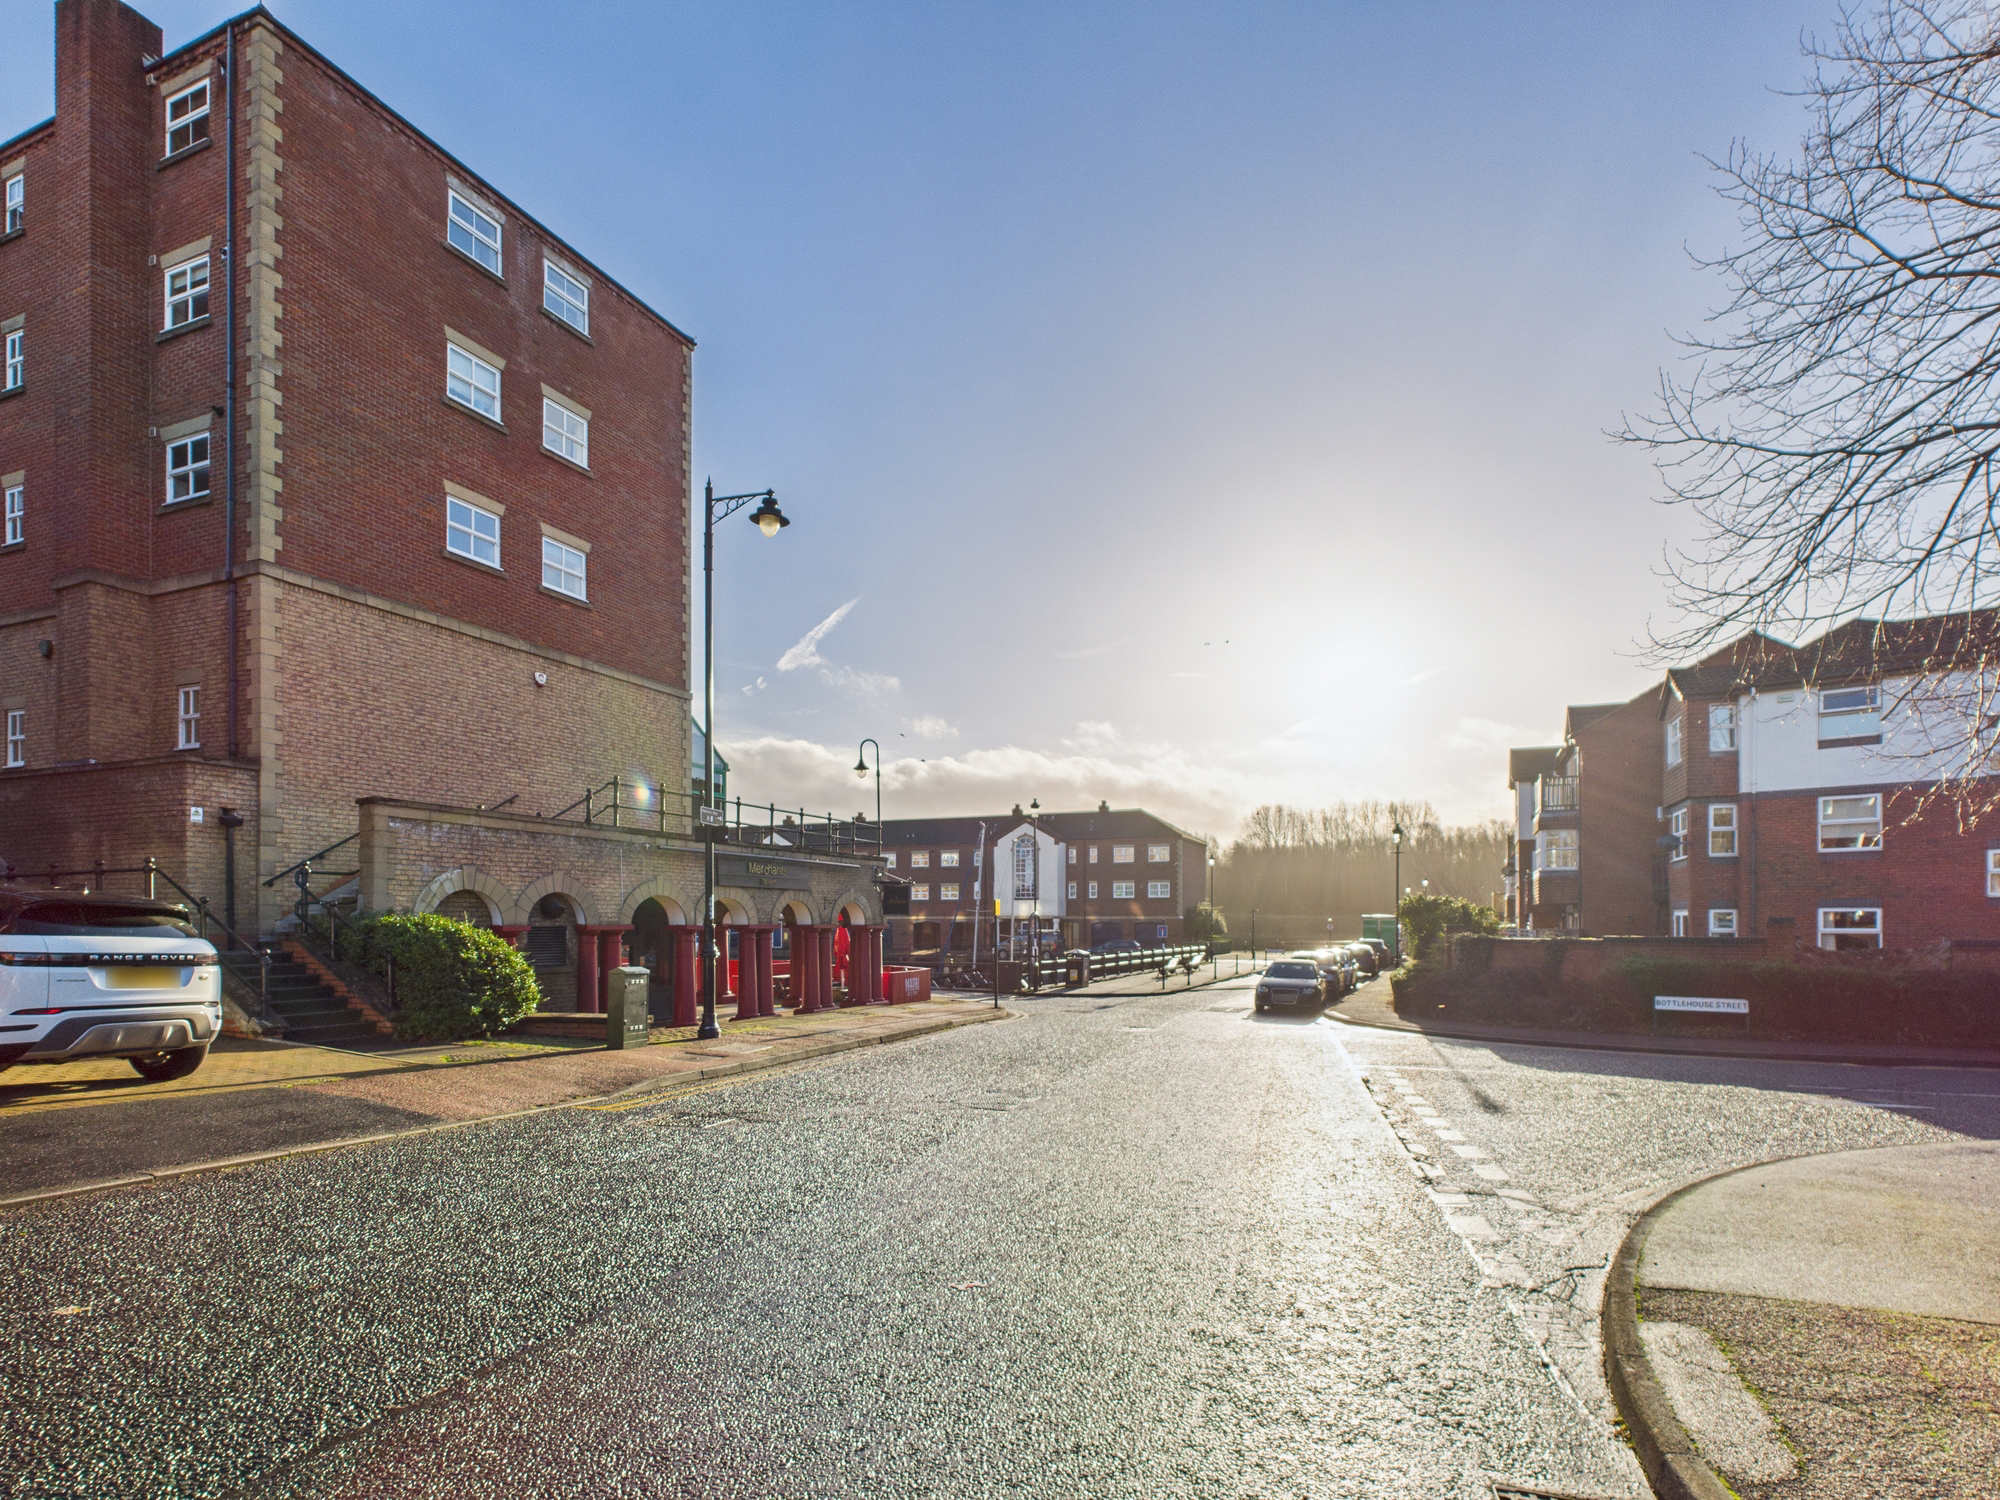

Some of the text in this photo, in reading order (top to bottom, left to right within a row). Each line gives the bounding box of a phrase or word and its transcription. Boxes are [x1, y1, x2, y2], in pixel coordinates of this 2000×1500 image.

[748, 861, 788, 876] Merchants
[1656, 999, 1748, 1010] BOTTLEHOUSE STREET
